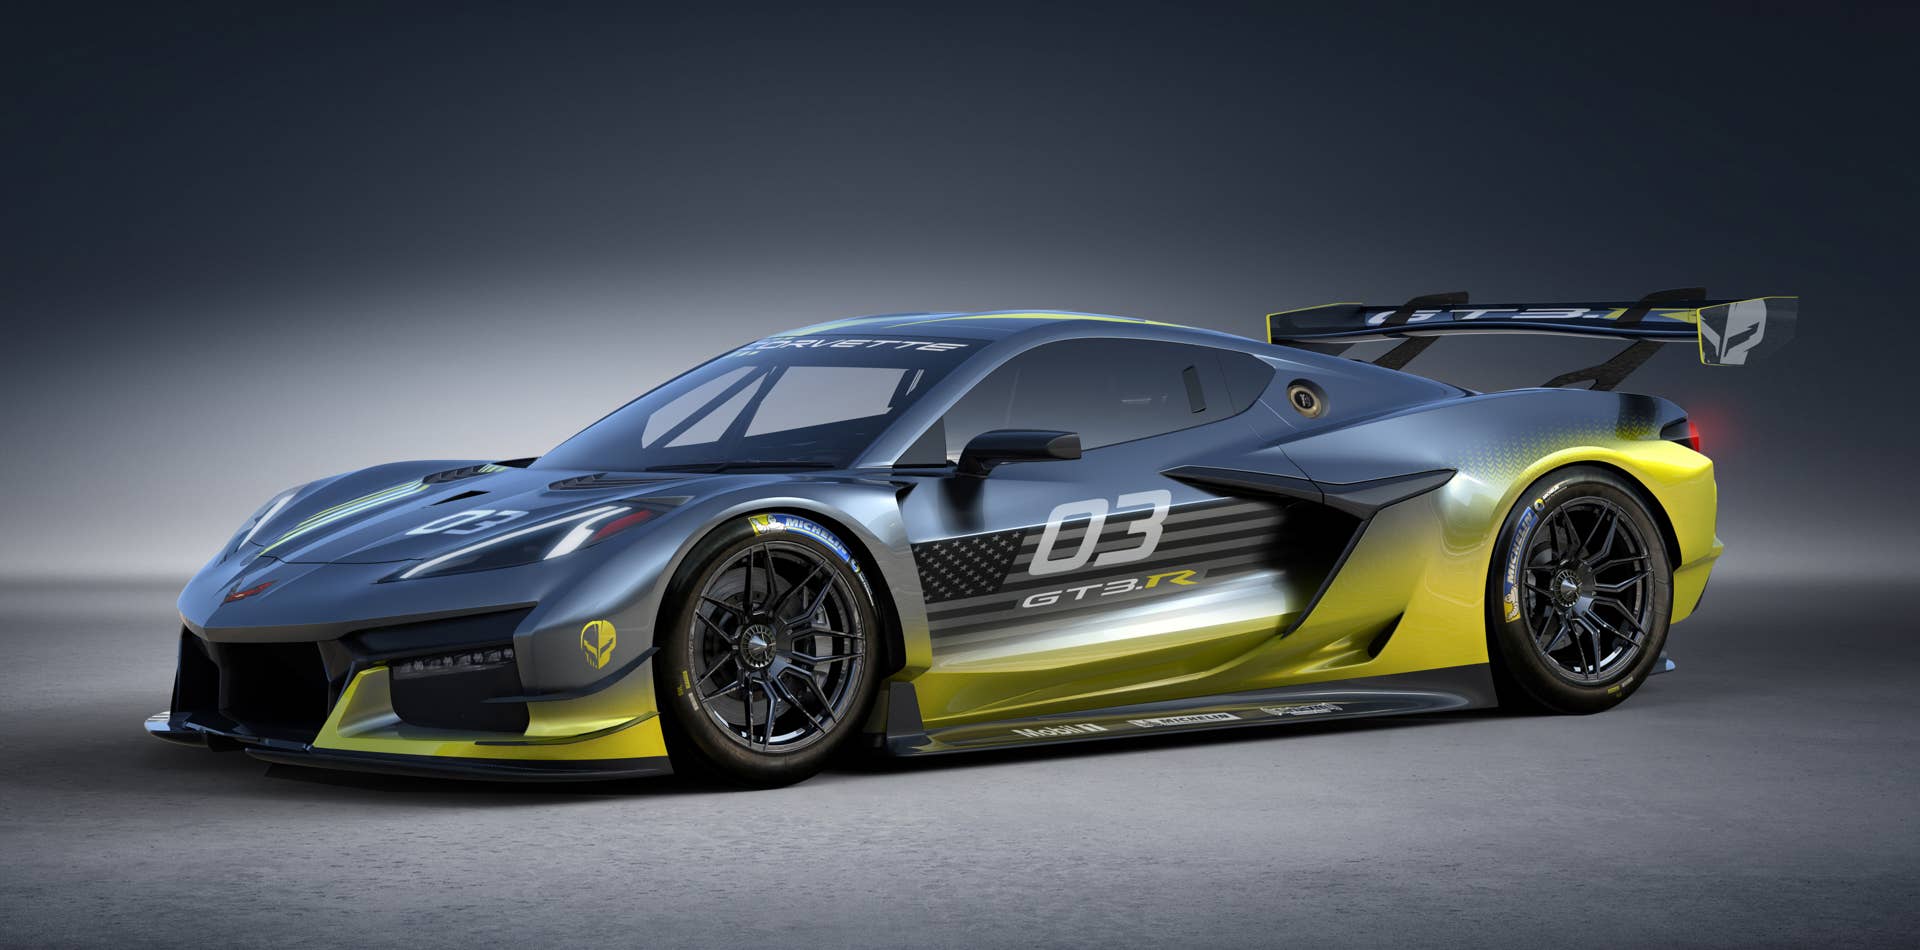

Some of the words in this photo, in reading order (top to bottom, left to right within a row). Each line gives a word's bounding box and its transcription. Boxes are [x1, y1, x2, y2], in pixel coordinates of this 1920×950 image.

[405, 510, 529, 535] 03
[785, 517, 849, 556] MICHELIN
[1028, 489, 1172, 576] 03
[1507, 512, 1533, 585] MICHELIN
[1022, 569, 1200, 608] GT3.R
[1011, 725, 1080, 738] Mobil
[1160, 713, 1230, 724] MICHELIN
